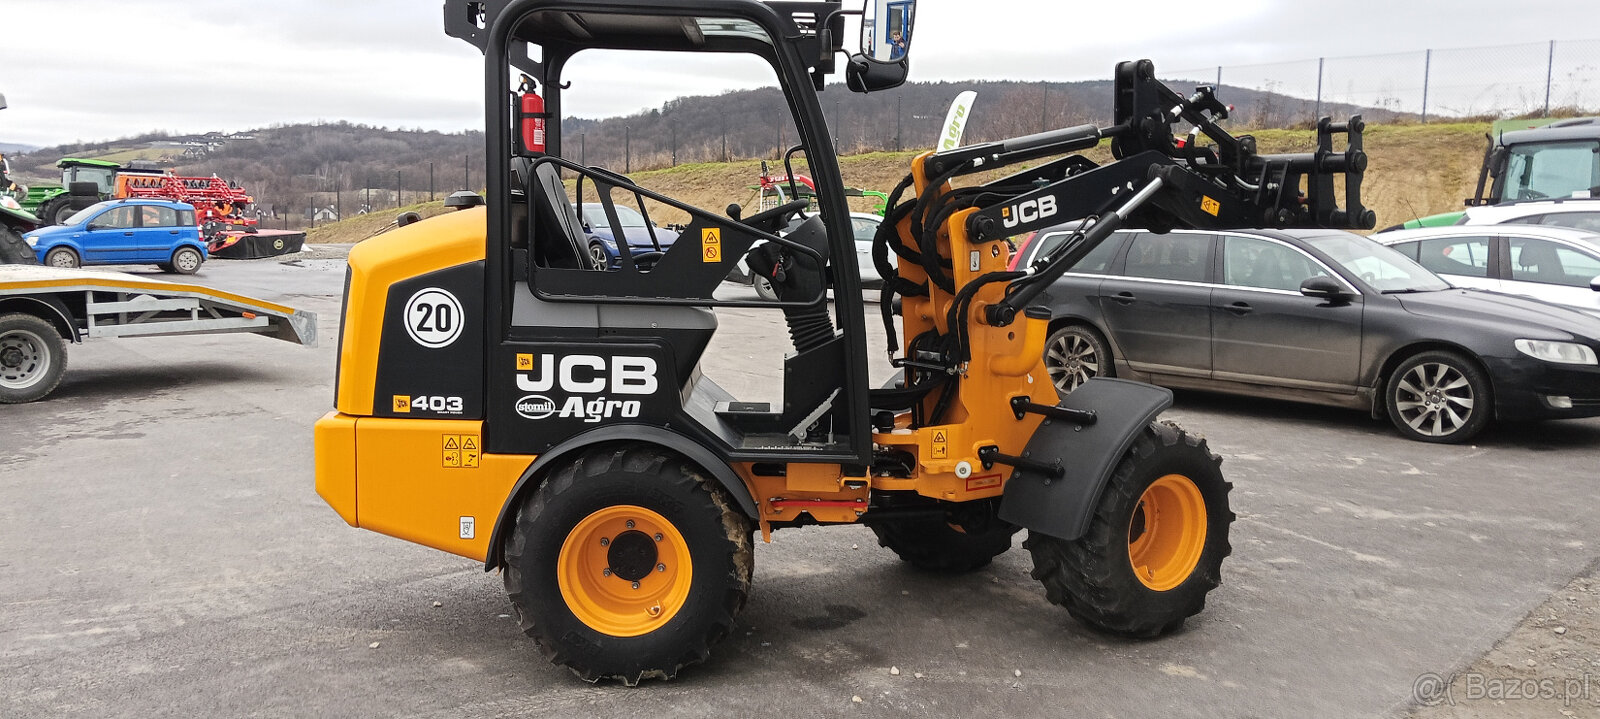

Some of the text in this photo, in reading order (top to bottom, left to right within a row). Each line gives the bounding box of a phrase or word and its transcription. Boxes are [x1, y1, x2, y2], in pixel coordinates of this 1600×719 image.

[1003, 194, 1058, 229] JCB
[416, 302, 452, 333] 20
[516, 353, 659, 395] JCB
[411, 395, 463, 411] 403
[518, 396, 641, 423] stomil Agro
